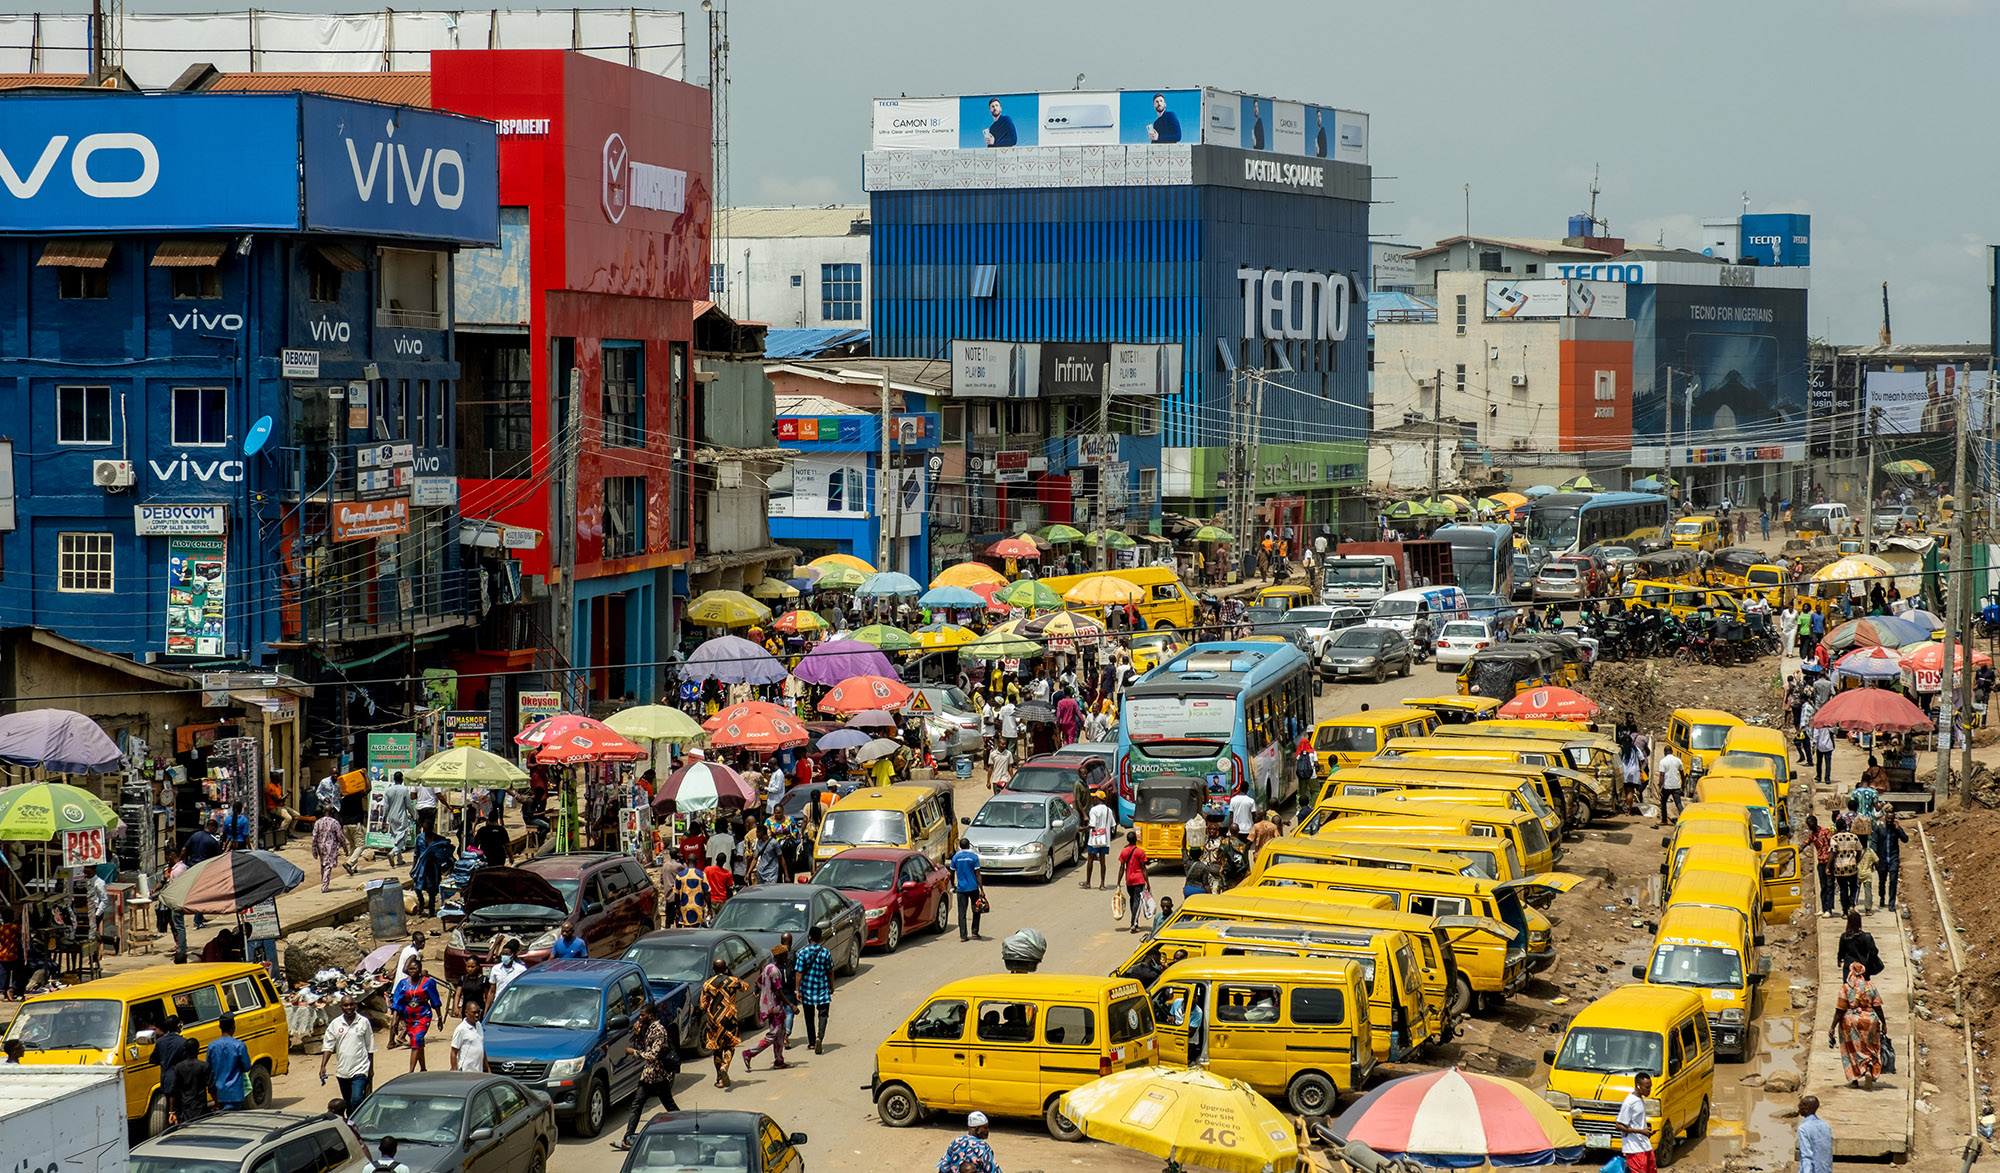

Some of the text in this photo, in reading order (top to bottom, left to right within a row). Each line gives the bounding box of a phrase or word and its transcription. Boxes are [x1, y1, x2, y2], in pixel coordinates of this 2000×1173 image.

[893, 119, 927, 127] CAMON
[346, 118, 465, 210] vivo
[1245, 158, 1324, 188] DIGITAL SQUARE
[1749, 236, 1781, 244] TECNO
[1557, 264, 1643, 285] TECNO
[1719, 266, 1755, 287] GOSHEN
[1237, 267, 1349, 341] TECNO
[168, 308, 244, 330] vivo
[1690, 305, 1774, 322] TECNO FOR NIGERIANS
[310, 314, 350, 342] vivo
[393, 334, 423, 354] vivo
[285, 351, 317, 366] DEBOCOM
[965, 347, 981, 361] NOTE
[1054, 357, 1094, 382] Infinix
[1871, 391, 1882, 402] You
[1883, 391, 1901, 402] mean
[149, 452, 244, 482] vivo
[412, 452, 440, 472] vivo
[795, 469, 813, 478] NOTE
[1263, 460, 1318, 486] 3C HUB
[143, 507, 215, 519] DEBOCOM
[172, 540, 223, 549] ALOY CONCEPT
[1049, 633, 1071, 645] POS
[1918, 671, 1941, 685] POS
[521, 696, 559, 707] Okeyson
[67, 830, 102, 862] POS
[1200, 1103, 1235, 1114] Upgrade
[1220, 1113, 1235, 1121] SIM
[1204, 1118, 1231, 1129] Device
[1200, 1127, 1237, 1148] 4G
